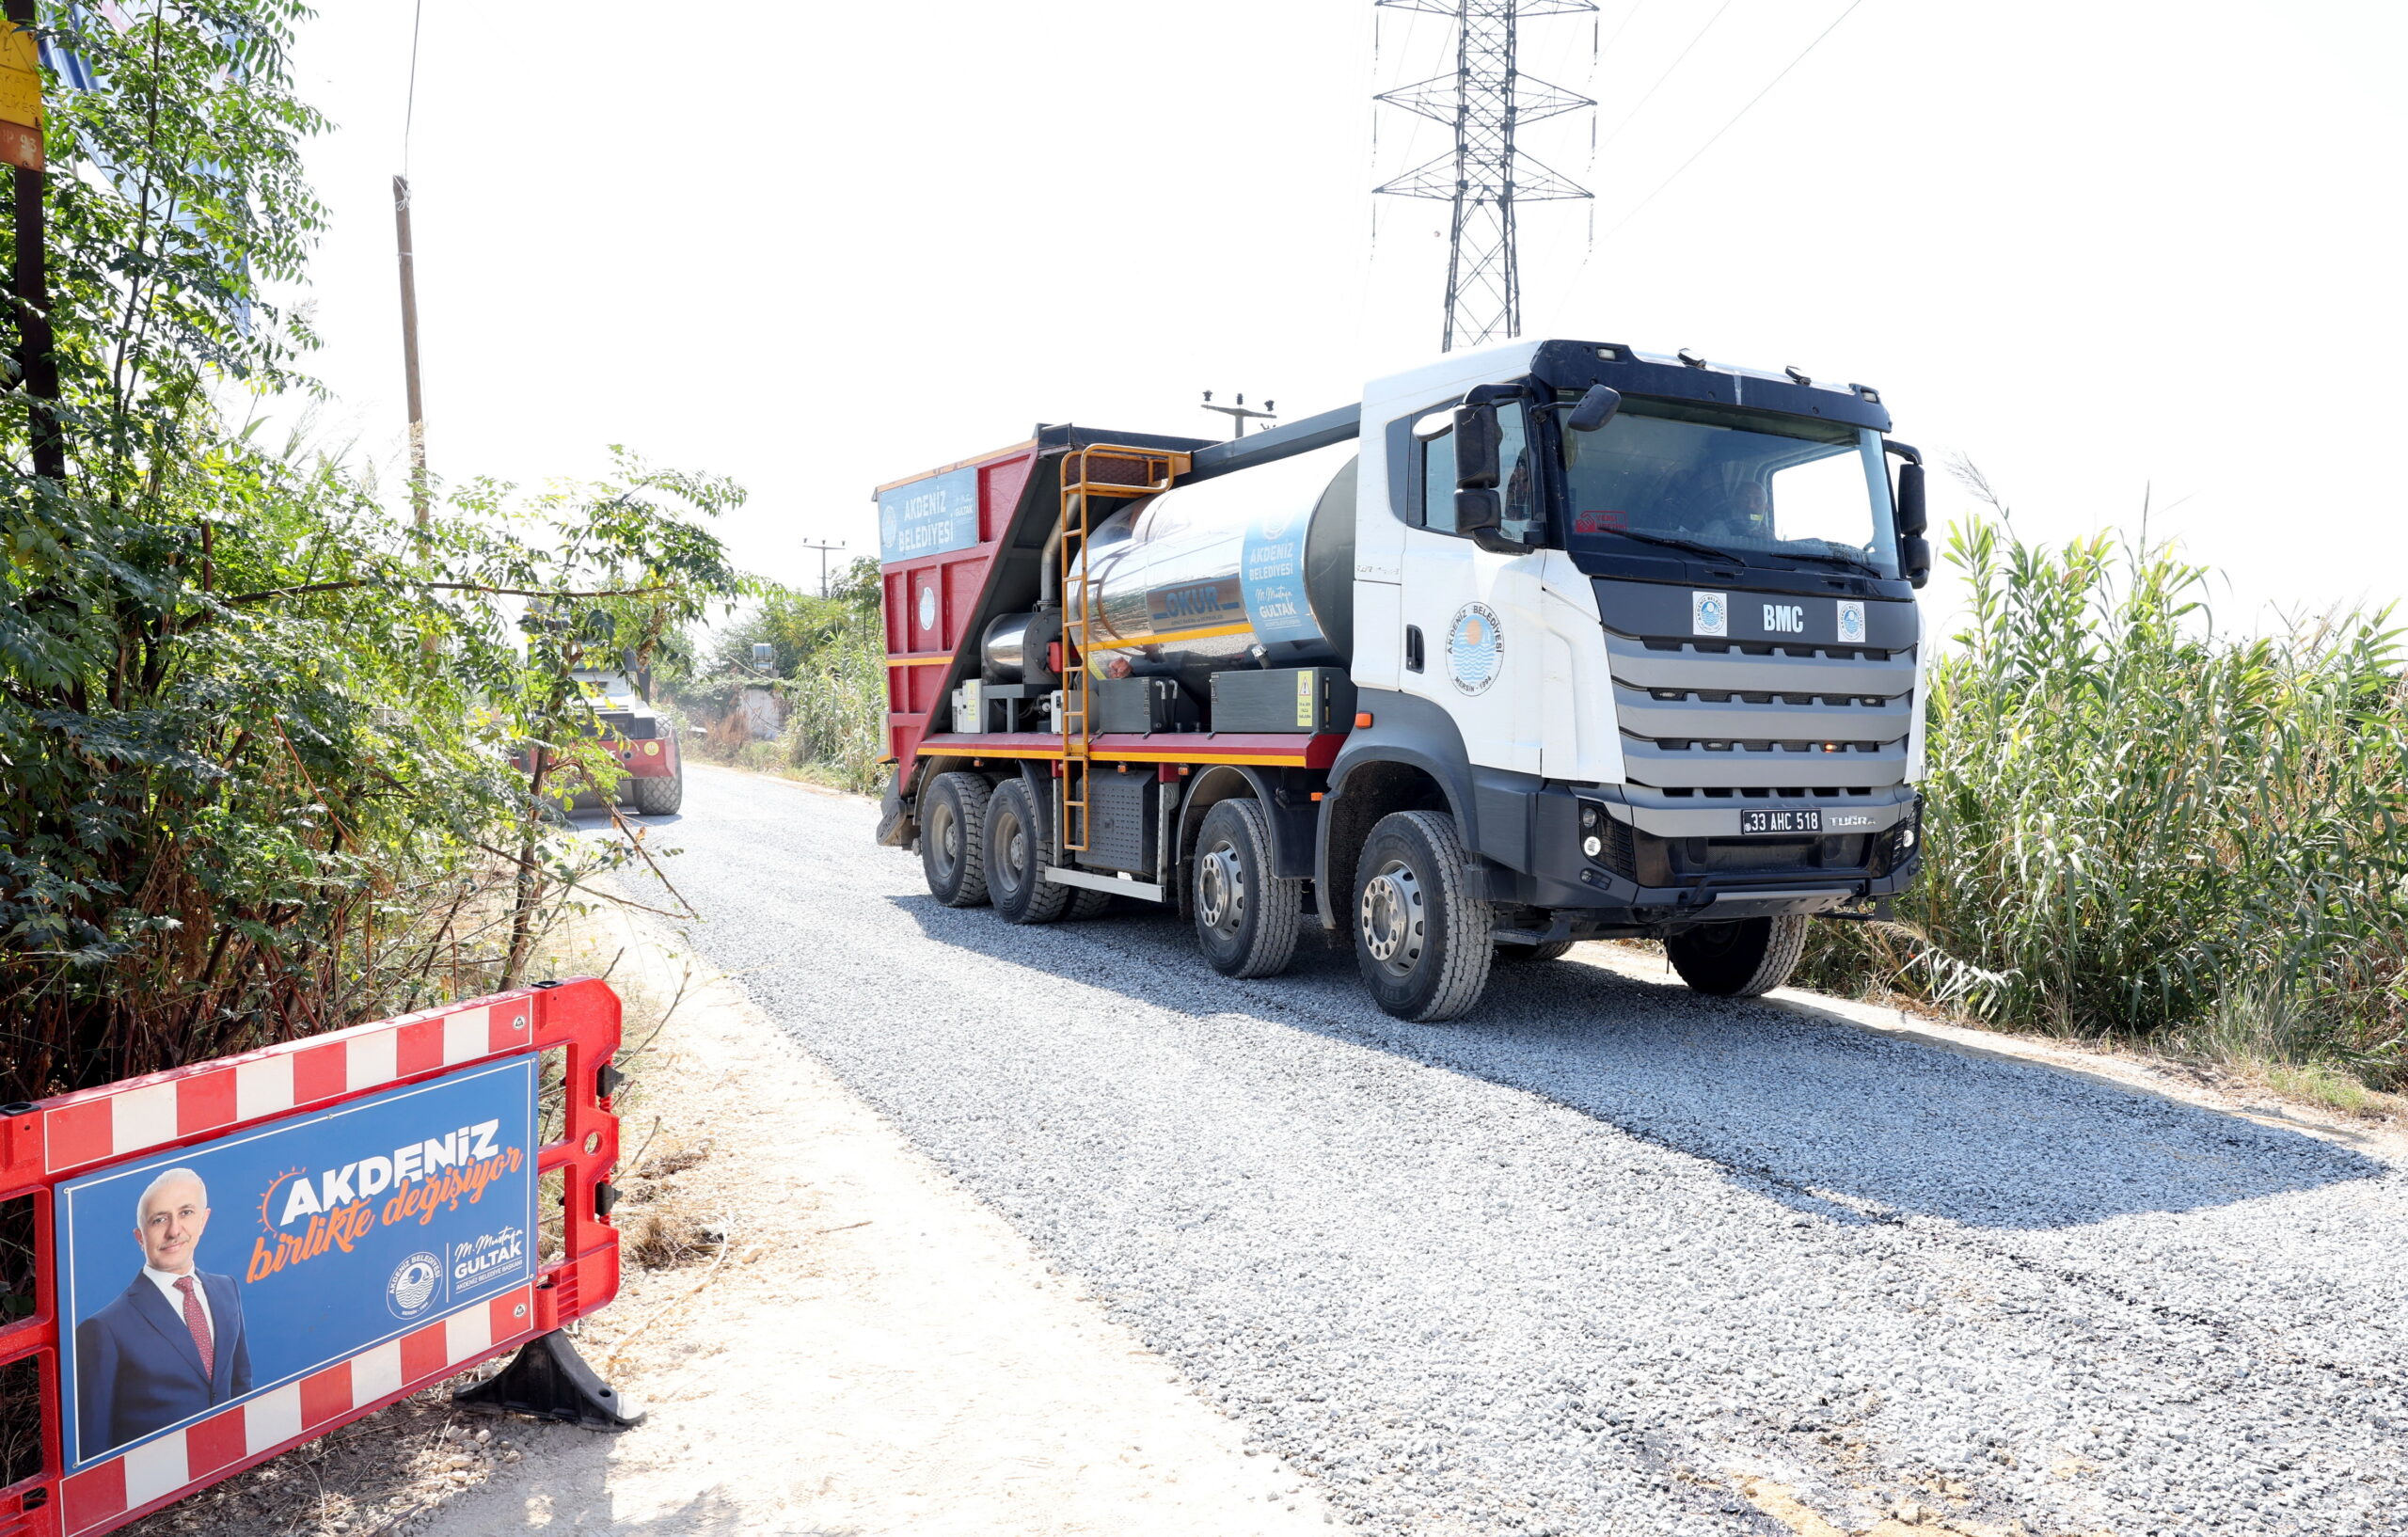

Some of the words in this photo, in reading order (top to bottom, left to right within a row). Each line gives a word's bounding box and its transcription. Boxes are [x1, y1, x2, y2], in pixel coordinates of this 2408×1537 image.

[904, 484, 946, 521] AKDENİZ
[898, 513, 954, 552] BELEDİYESİ
[1250, 539, 1294, 564] AKDENİZ
[1249, 559, 1293, 581] BELEDİYESİ
[1166, 586, 1221, 617] OKUR
[1763, 604, 1803, 633] BMC
[1447, 610, 1468, 655] AKDENİZ
[1473, 605, 1503, 653] BELEDİYESİ
[1751, 813, 1766, 831] 33
[1770, 812, 1792, 831] AHC
[1797, 812, 1818, 830] 518
[279, 1118, 499, 1227] AKDENİZ
[246, 1196, 376, 1283] birlikte
[382, 1146, 523, 1226] değişiyor
[454, 1242, 475, 1262] M.
[475, 1226, 523, 1255] Mustafa
[389, 1260, 410, 1294] AKDENİZ
[411, 1254, 441, 1278] BELEDİYESİ
